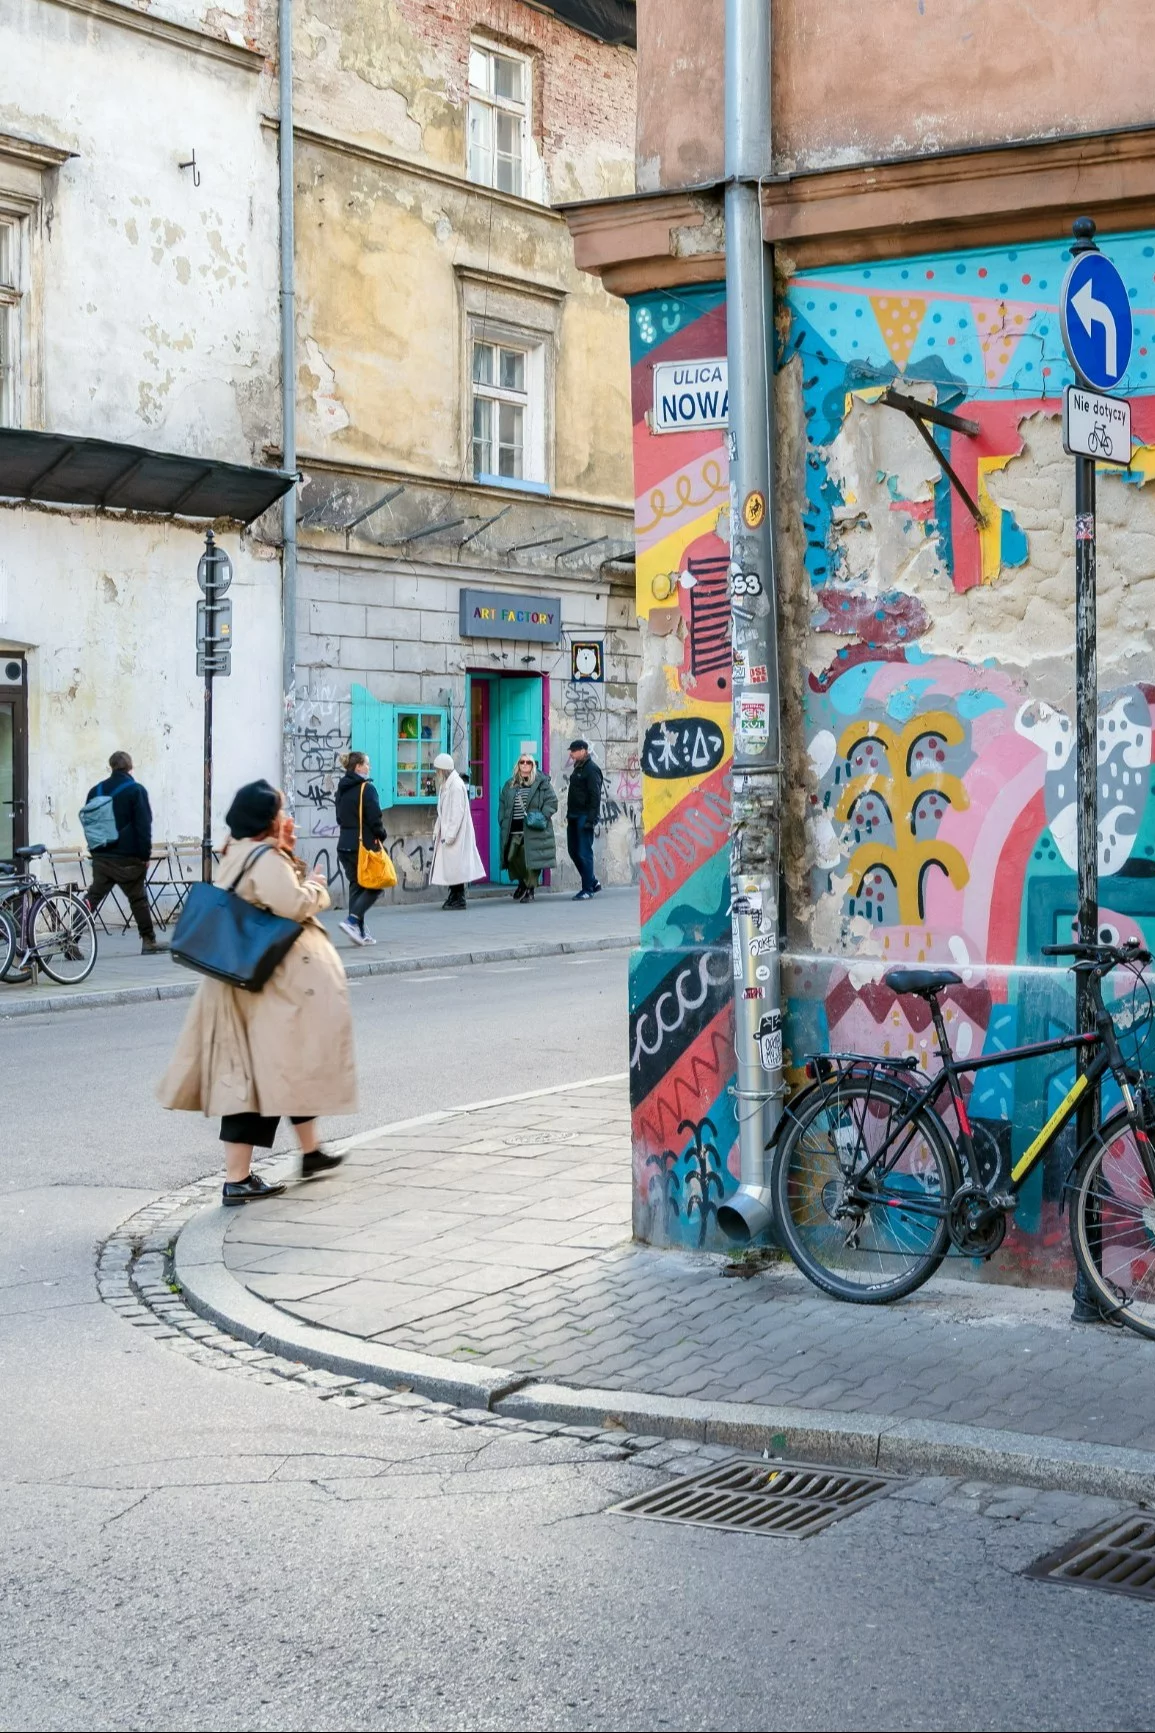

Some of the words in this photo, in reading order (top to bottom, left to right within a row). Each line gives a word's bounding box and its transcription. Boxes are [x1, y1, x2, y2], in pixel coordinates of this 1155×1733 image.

[673, 366, 723, 385] ULICA
[1073, 394, 1090, 413] Nie
[1093, 399, 1127, 426] dotyczy
[473, 606, 496, 621] ART
[501, 608, 555, 625] FACTORY
